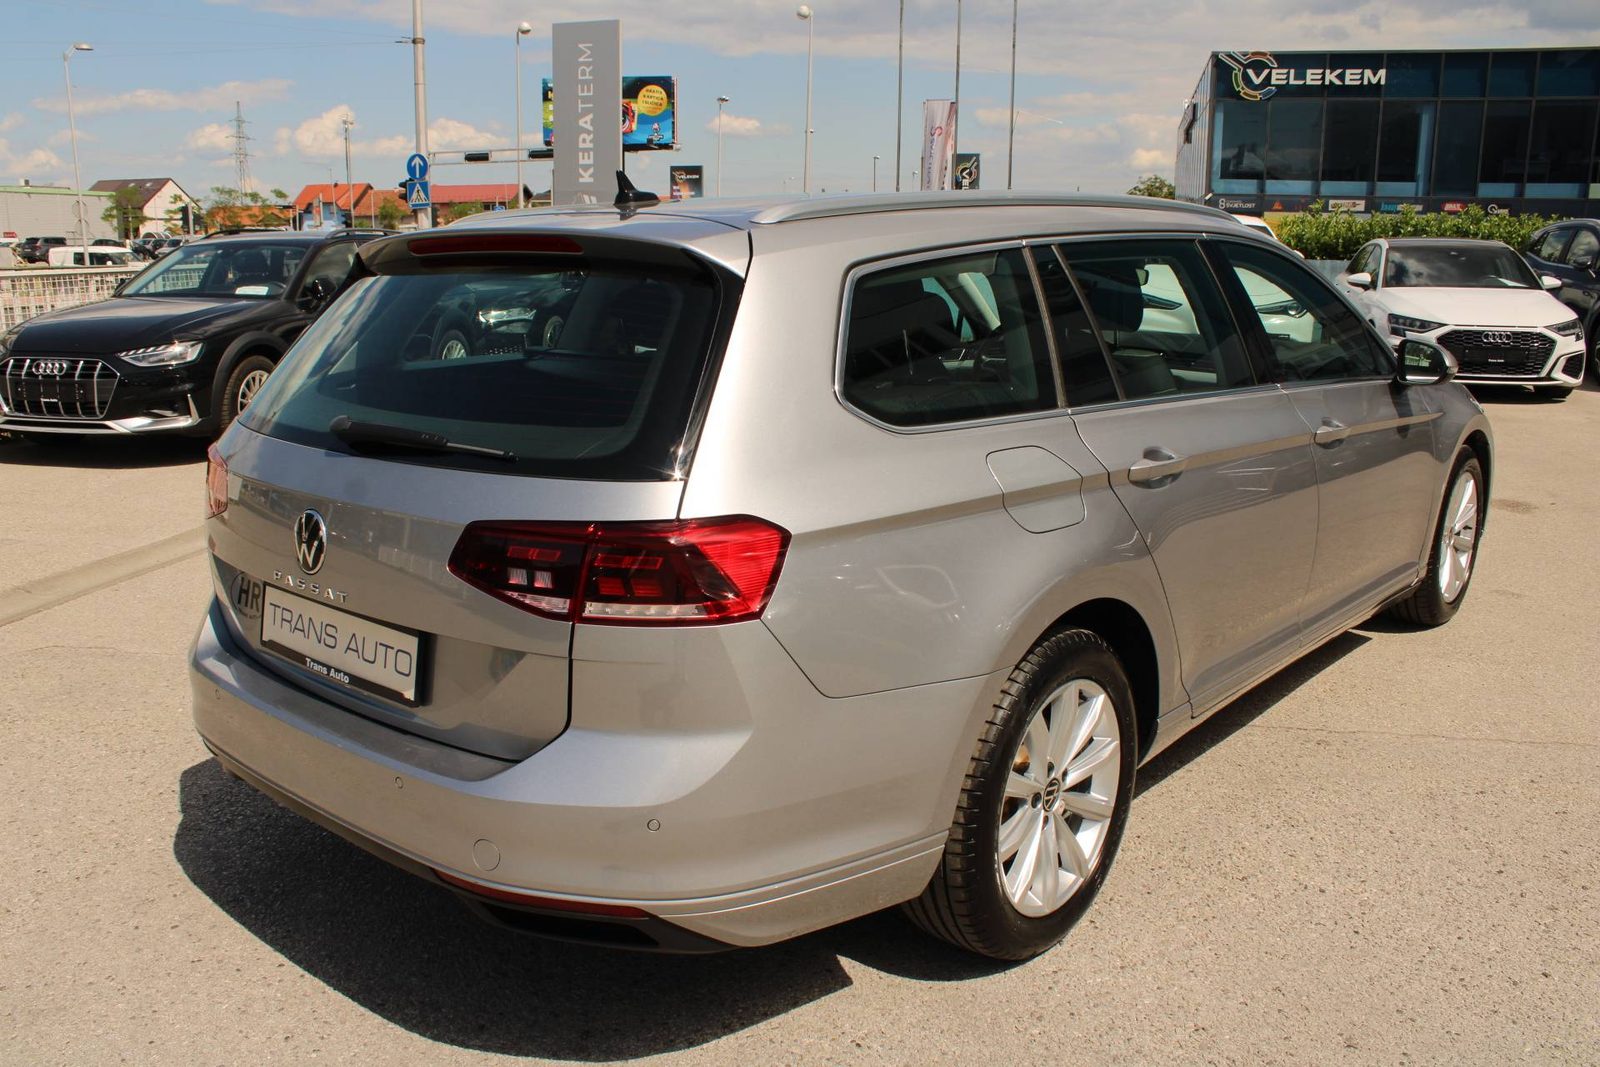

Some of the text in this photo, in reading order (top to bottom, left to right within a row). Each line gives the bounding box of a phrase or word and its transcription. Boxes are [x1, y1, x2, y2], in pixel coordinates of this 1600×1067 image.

[1246, 68, 1387, 86] VELEKEM
[578, 43, 594, 183] KERATERM
[237, 576, 262, 613] HR
[273, 569, 349, 604] PASSAT
[269, 602, 412, 678] TRANS AUTO
[305, 657, 350, 685] Trans Auto
